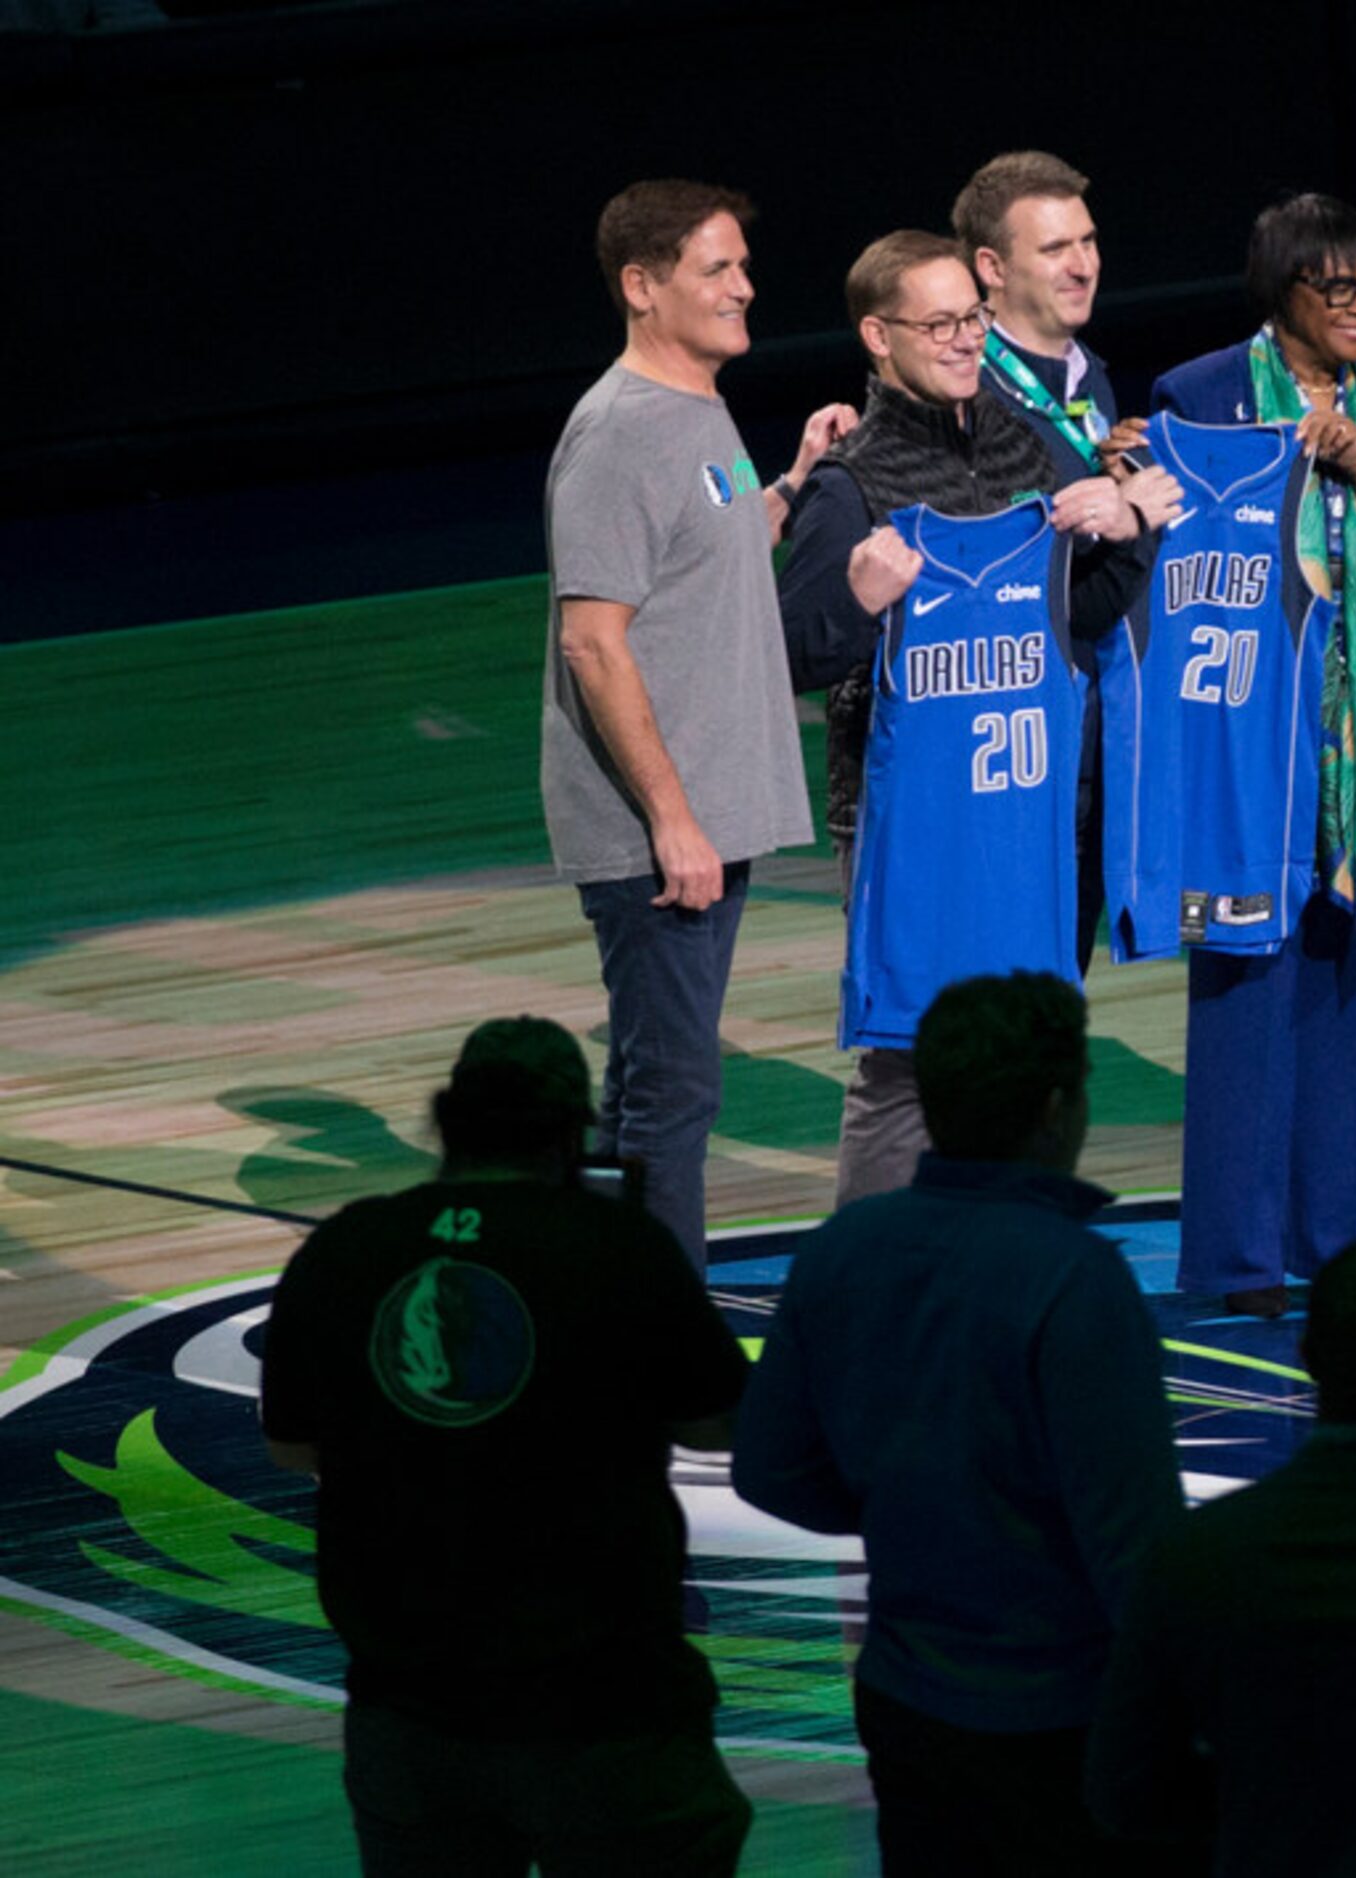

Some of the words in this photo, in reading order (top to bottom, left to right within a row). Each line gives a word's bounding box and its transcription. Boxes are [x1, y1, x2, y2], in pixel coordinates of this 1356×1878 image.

[996, 583, 1041, 602] chime
[906, 632, 1045, 702] DALLAS
[1180, 625, 1259, 708] 20
[972, 707, 1047, 793] 20
[429, 1208, 482, 1242] 42
